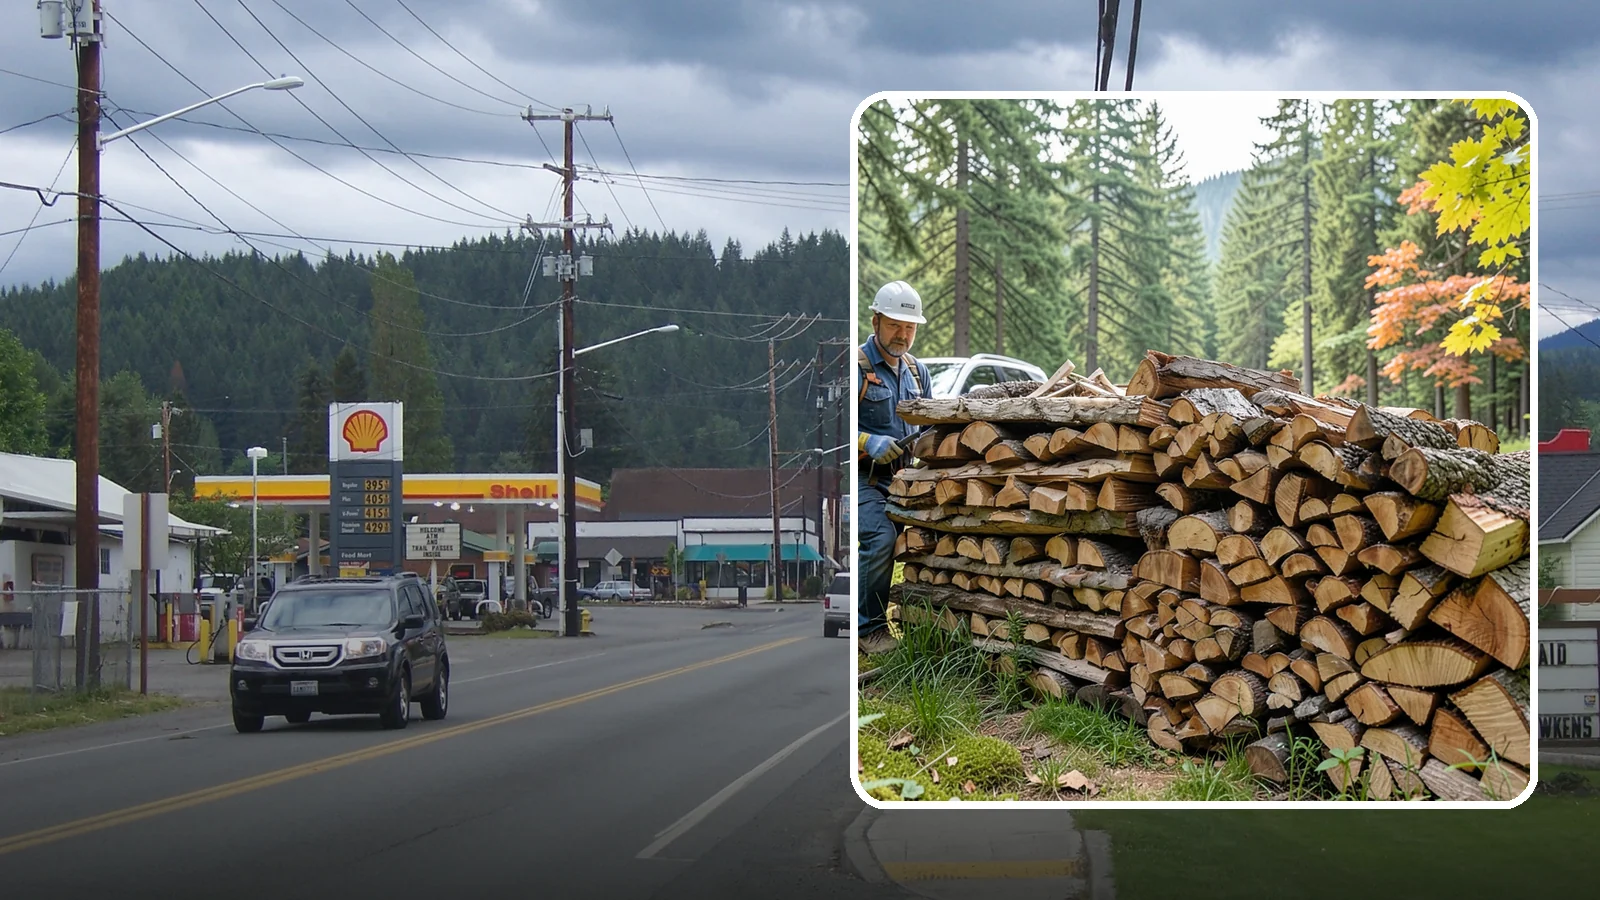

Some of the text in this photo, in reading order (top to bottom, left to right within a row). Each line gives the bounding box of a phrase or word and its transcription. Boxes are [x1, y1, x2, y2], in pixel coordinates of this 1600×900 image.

[366, 480, 384, 490] 395
[490, 484, 547, 499] Shell
[366, 494, 384, 504] 405
[366, 508, 384, 518] 415
[366, 522, 384, 532] 429
[1538, 643, 1567, 665] AID
